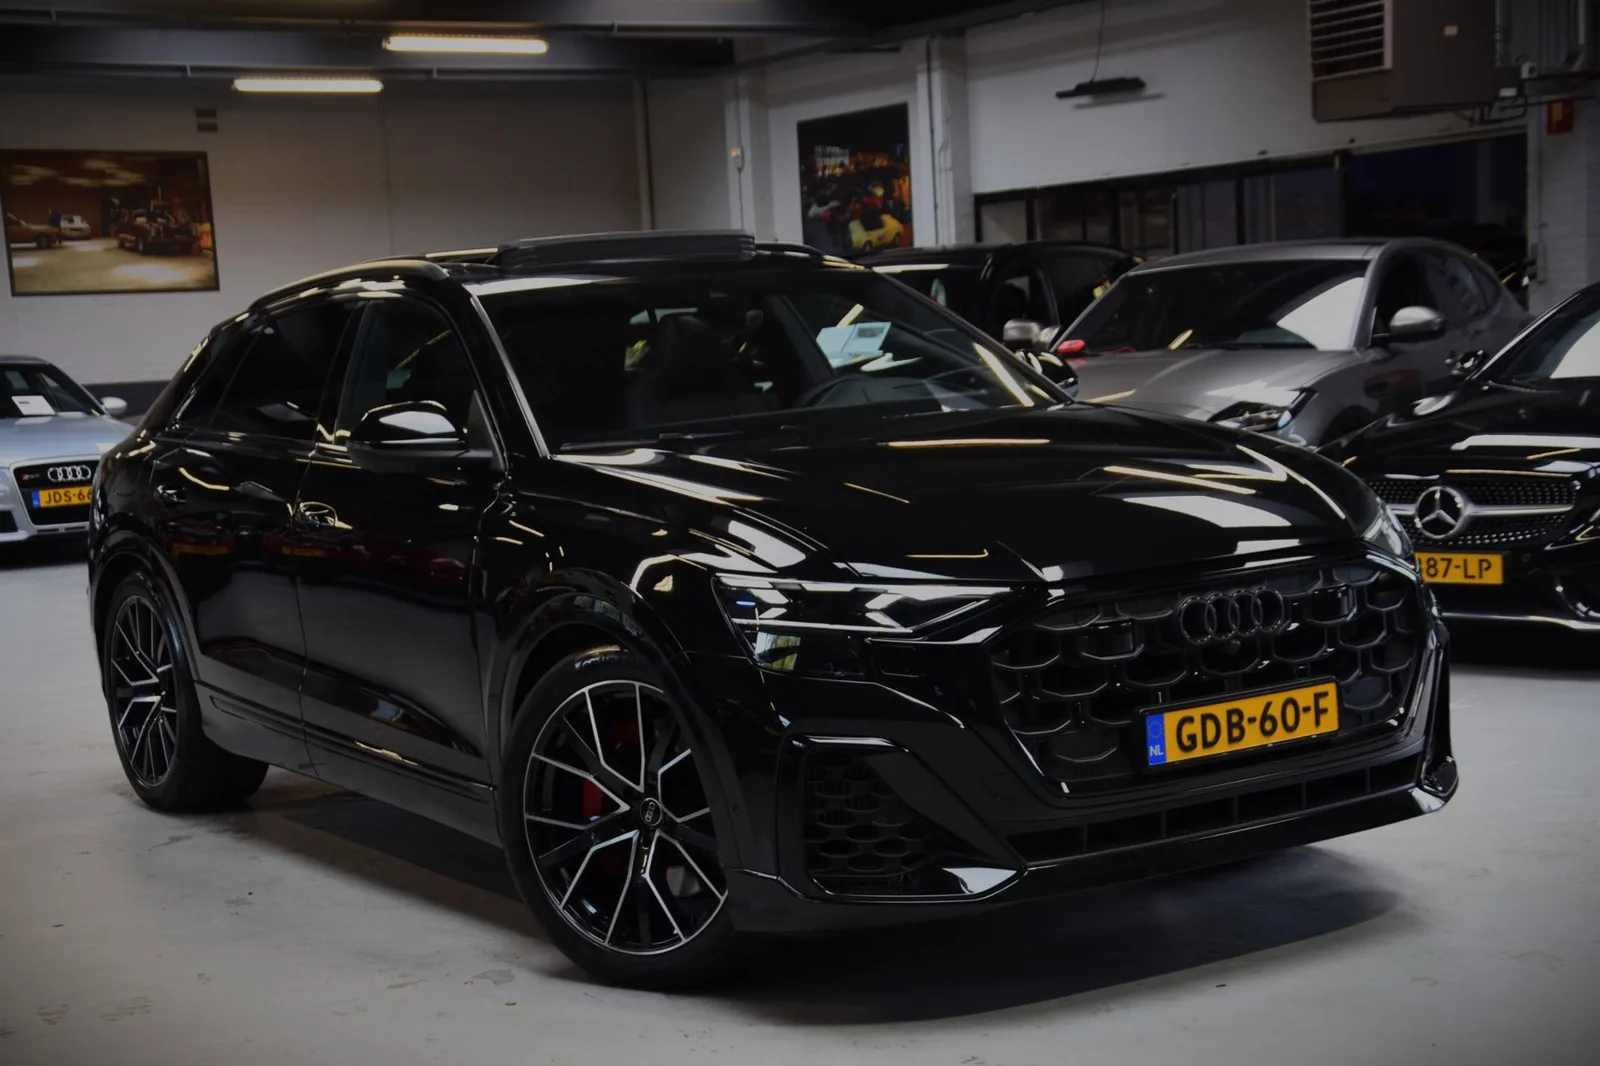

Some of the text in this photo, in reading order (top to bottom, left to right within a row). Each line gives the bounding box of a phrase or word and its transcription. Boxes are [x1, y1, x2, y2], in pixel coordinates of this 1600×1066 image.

[1418, 557, 1492, 579] 87-LP
[1176, 690, 1329, 753] GDB-60-F
[1149, 745, 1164, 757] NL
